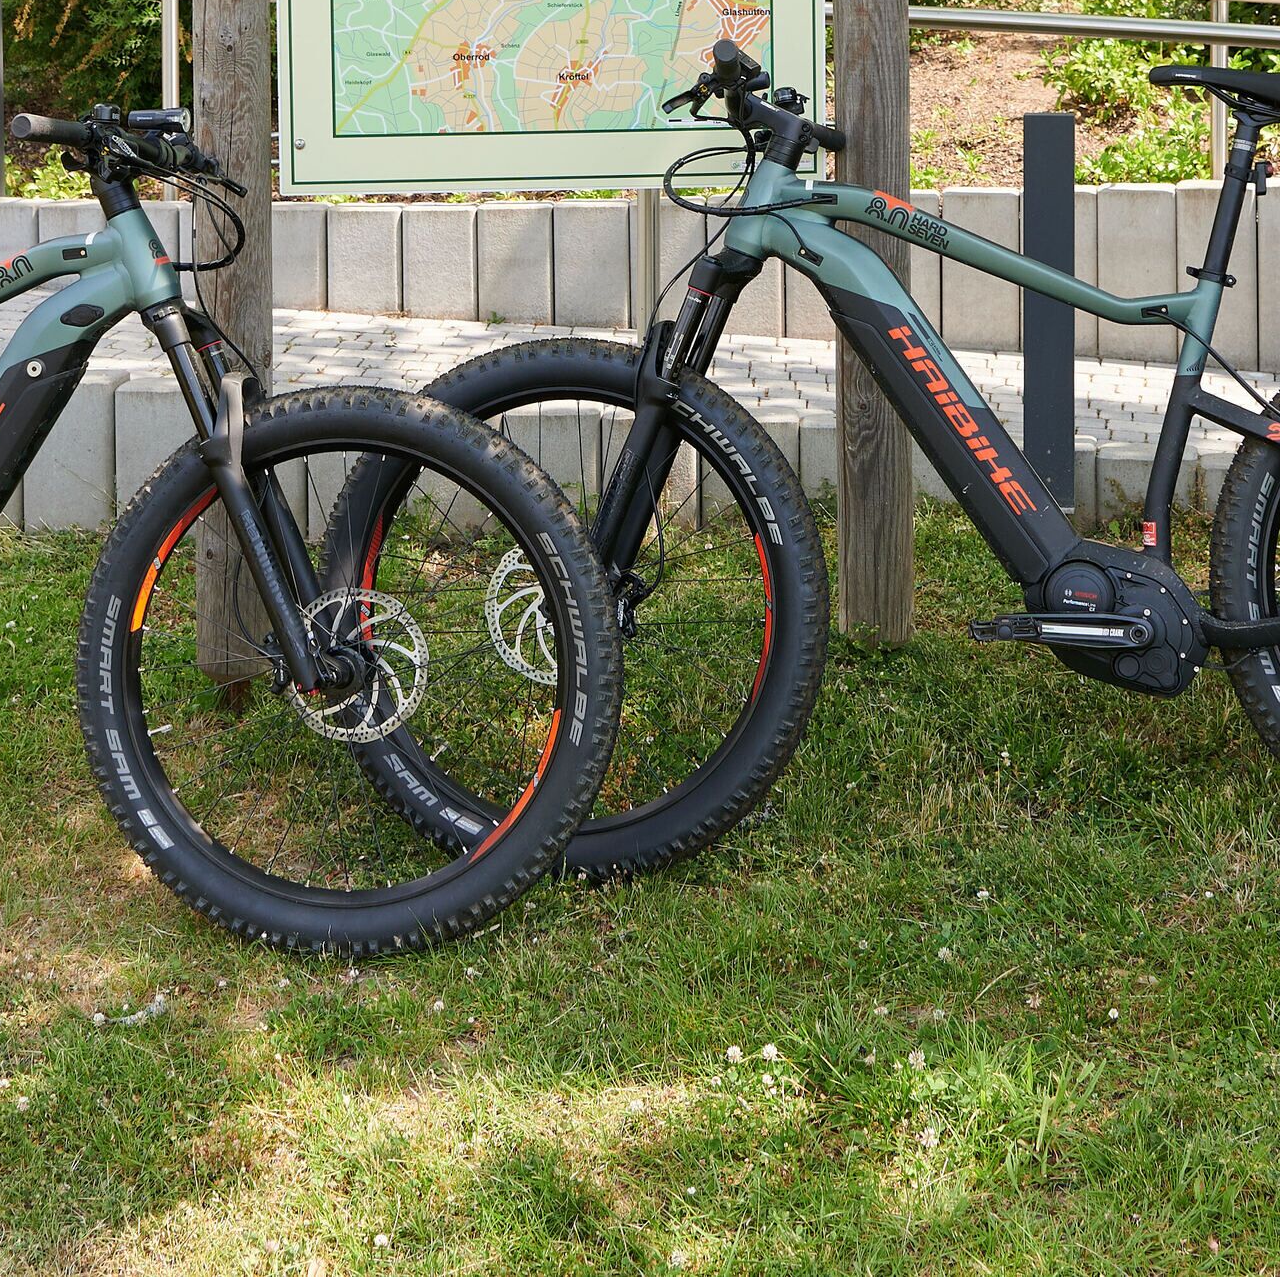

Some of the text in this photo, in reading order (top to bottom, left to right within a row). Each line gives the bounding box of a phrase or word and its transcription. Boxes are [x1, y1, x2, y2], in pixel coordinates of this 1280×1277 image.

[722, 8, 771, 16] Glashütten
[452, 53, 491, 61] Oberrod
[559, 73, 590, 81] Kröftel
[907, 224, 950, 250] SEVEN
[911, 213, 948, 237] HARD
[671, 400, 784, 546] CHWALBE
[1246, 471, 1277, 675] SMART SM
[537, 531, 590, 747] SCHWALBE
[99, 594, 142, 800] SMART SAM
[383, 753, 438, 807] SAM
